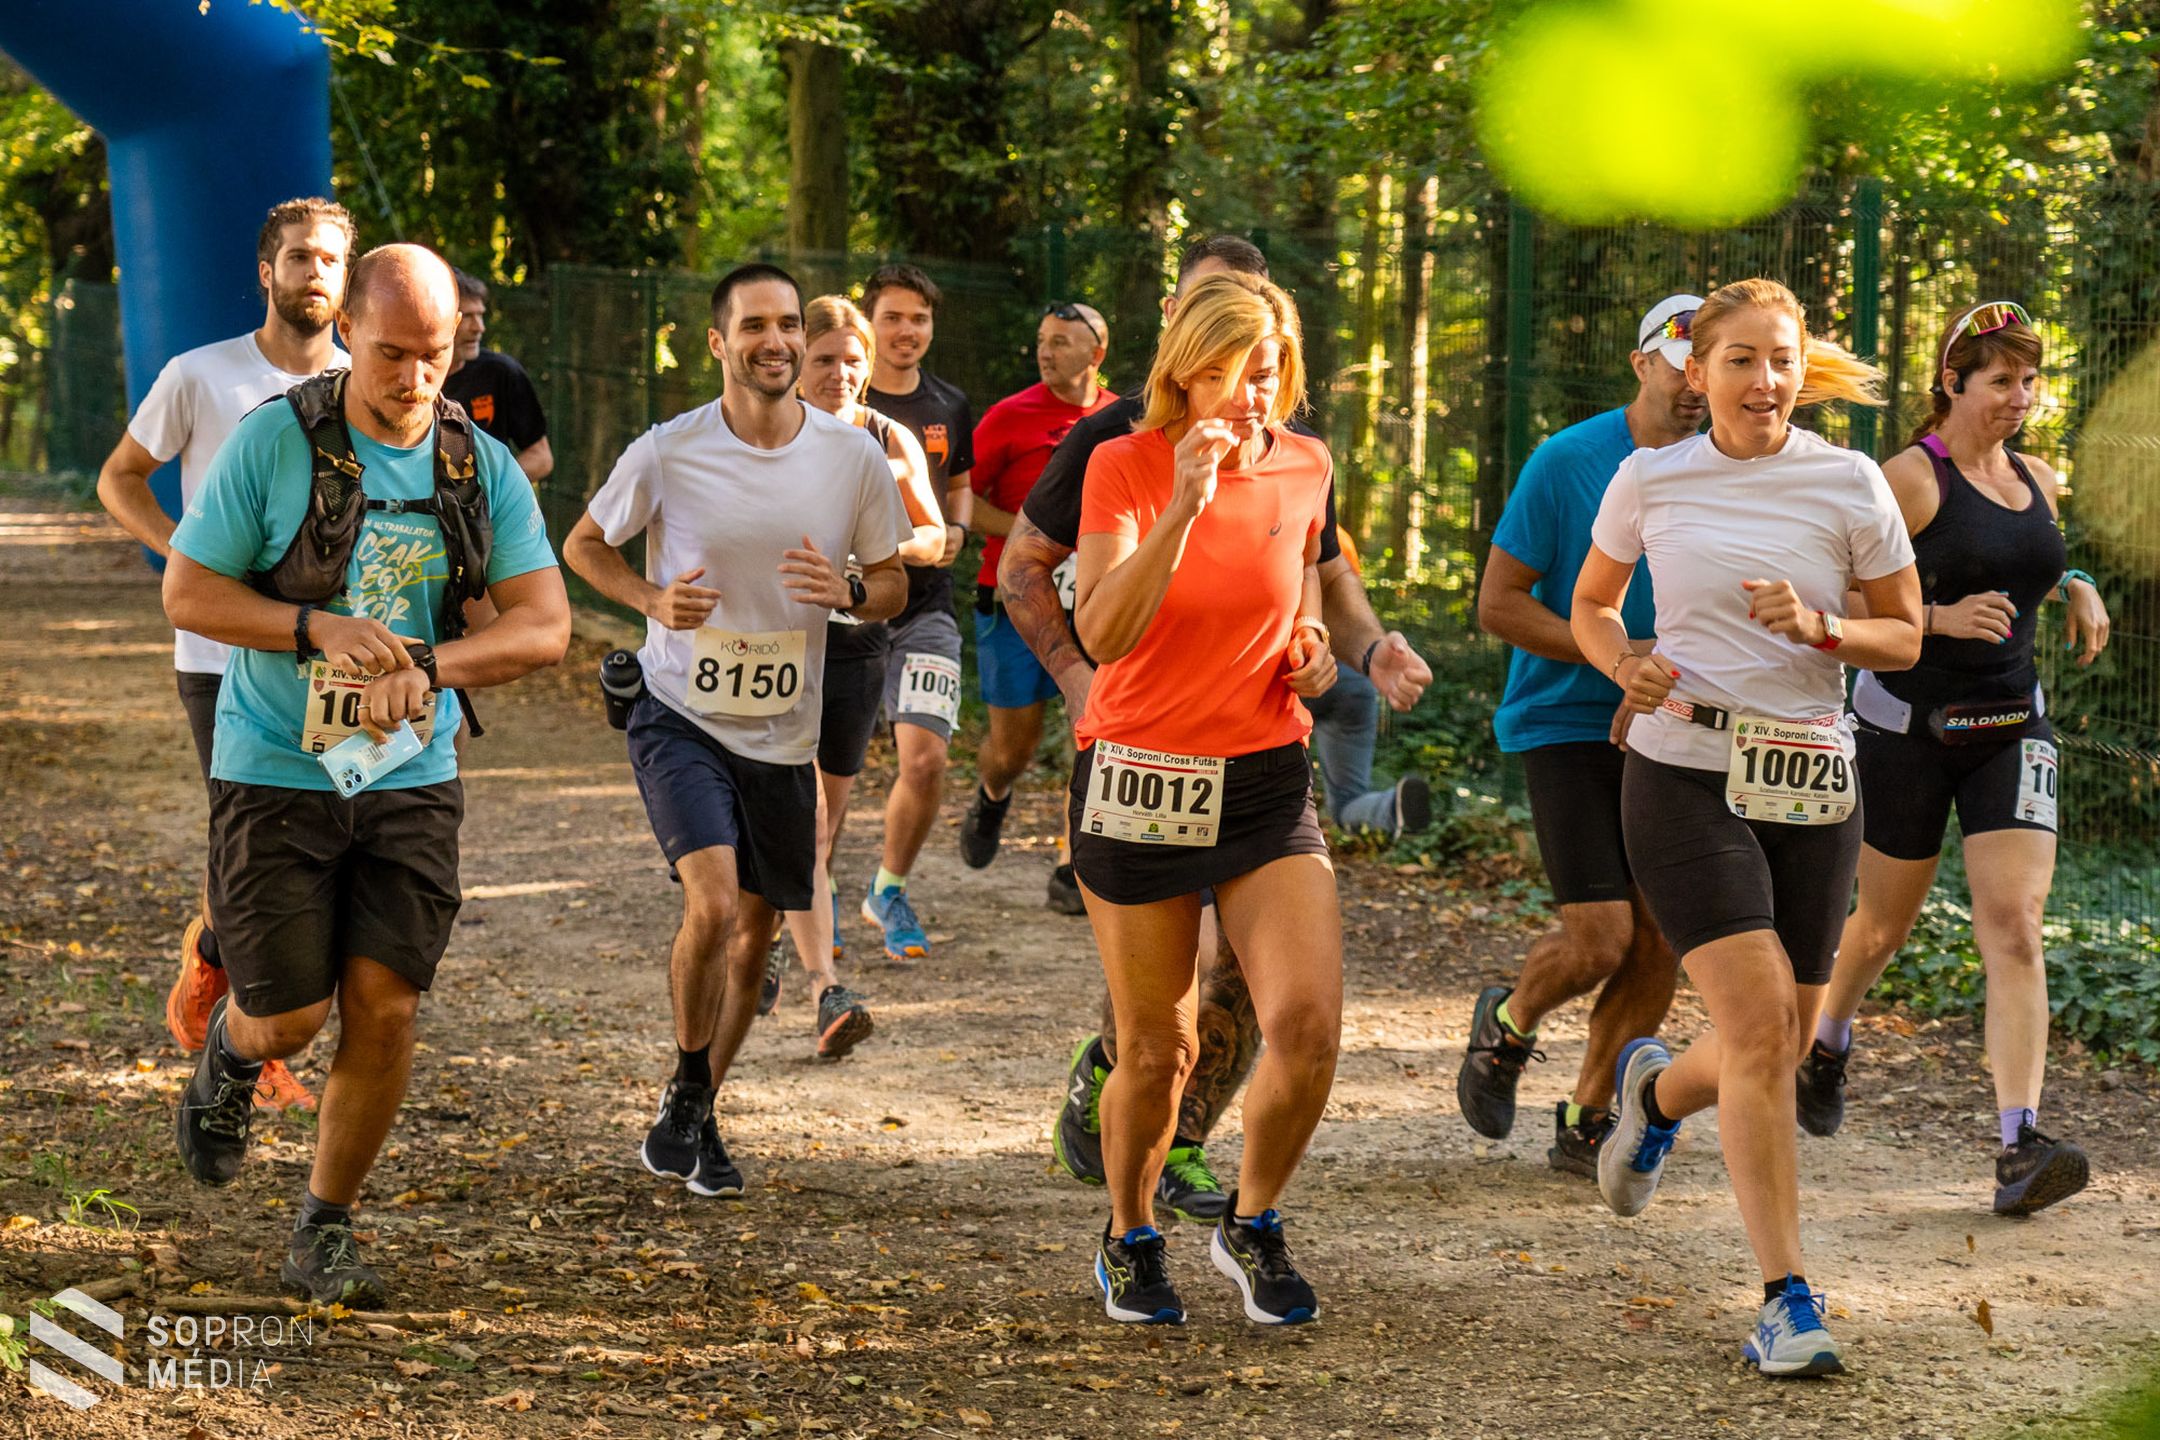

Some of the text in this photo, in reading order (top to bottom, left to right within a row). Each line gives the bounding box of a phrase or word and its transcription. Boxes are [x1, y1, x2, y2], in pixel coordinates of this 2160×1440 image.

[357, 531, 432, 570] CSAK
[360, 564, 414, 596] EGY
[695, 657, 798, 699] 8150
[1754, 725, 1771, 736] XIV.
[1774, 728, 1809, 740] Soproni
[1947, 711, 2030, 726] SALOMON
[1110, 744, 1124, 756] XIV.
[1127, 748, 1162, 761] Soproni
[1164, 755, 1190, 765] Cross
[1193, 756, 1218, 767] Futás
[1742, 747, 1848, 793] 10029
[1100, 765, 1213, 815] 10012
